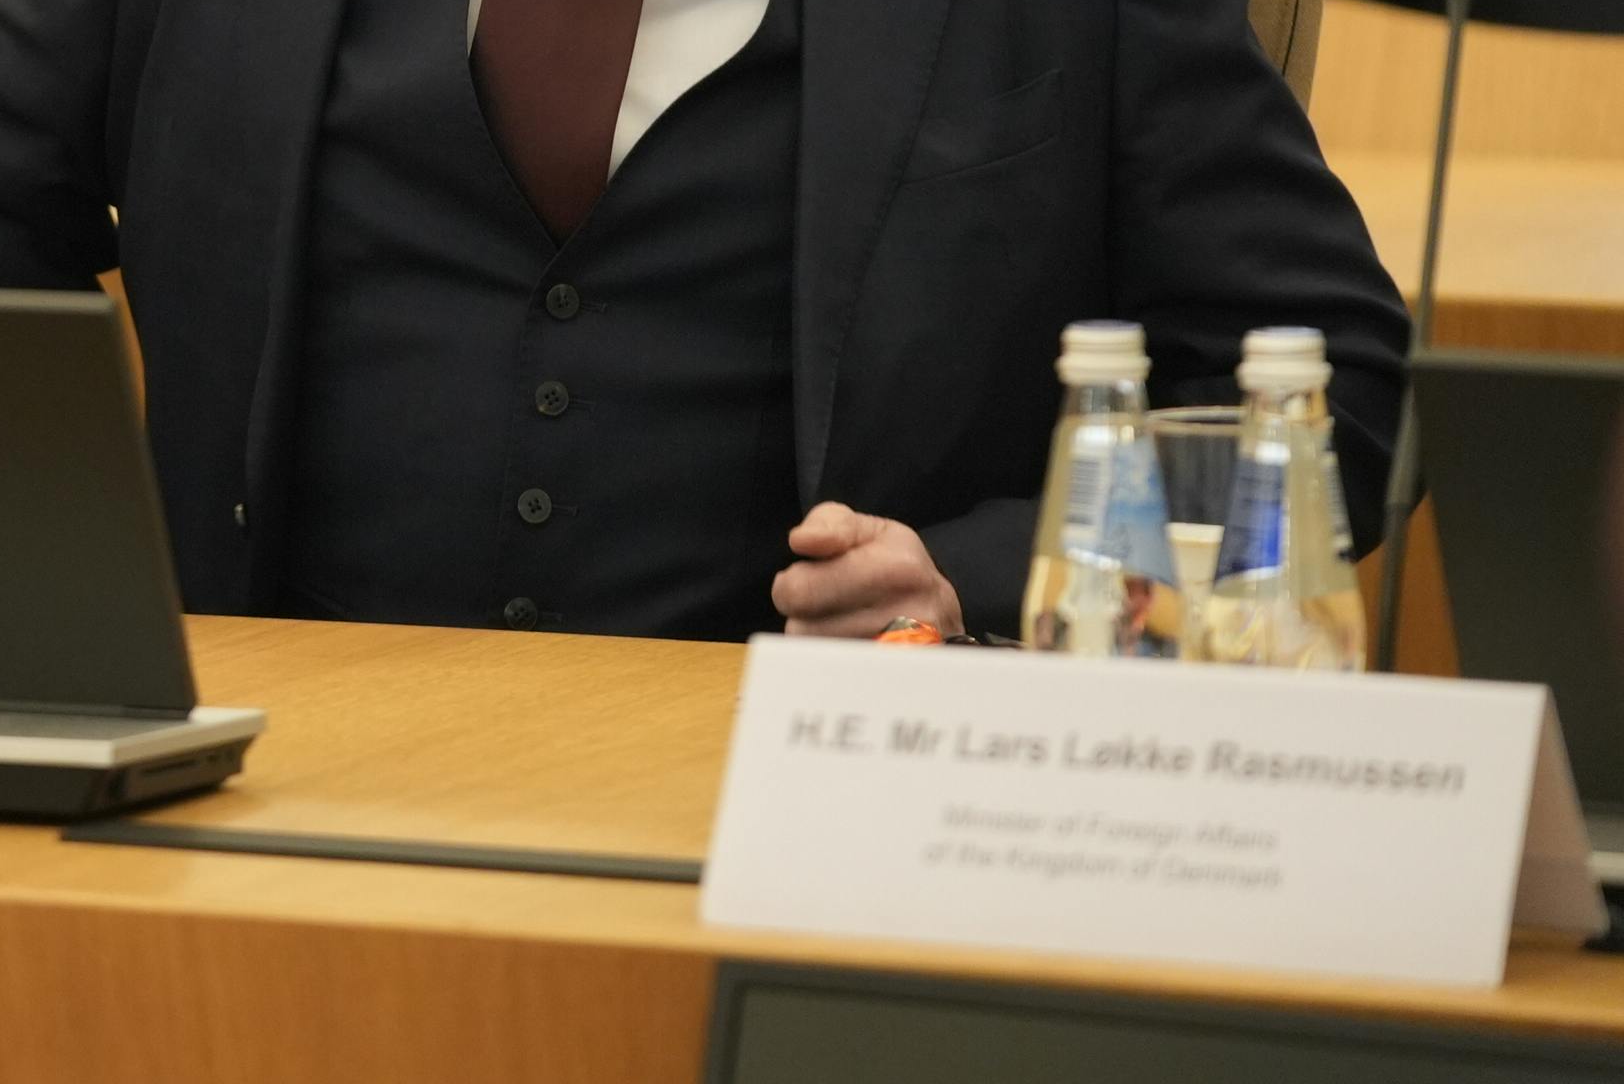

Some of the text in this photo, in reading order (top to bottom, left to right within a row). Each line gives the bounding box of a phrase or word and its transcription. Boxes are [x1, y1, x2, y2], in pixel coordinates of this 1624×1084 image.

[787, 713, 1467, 794] H.E. Mr Lars Løkke Rasmussen
